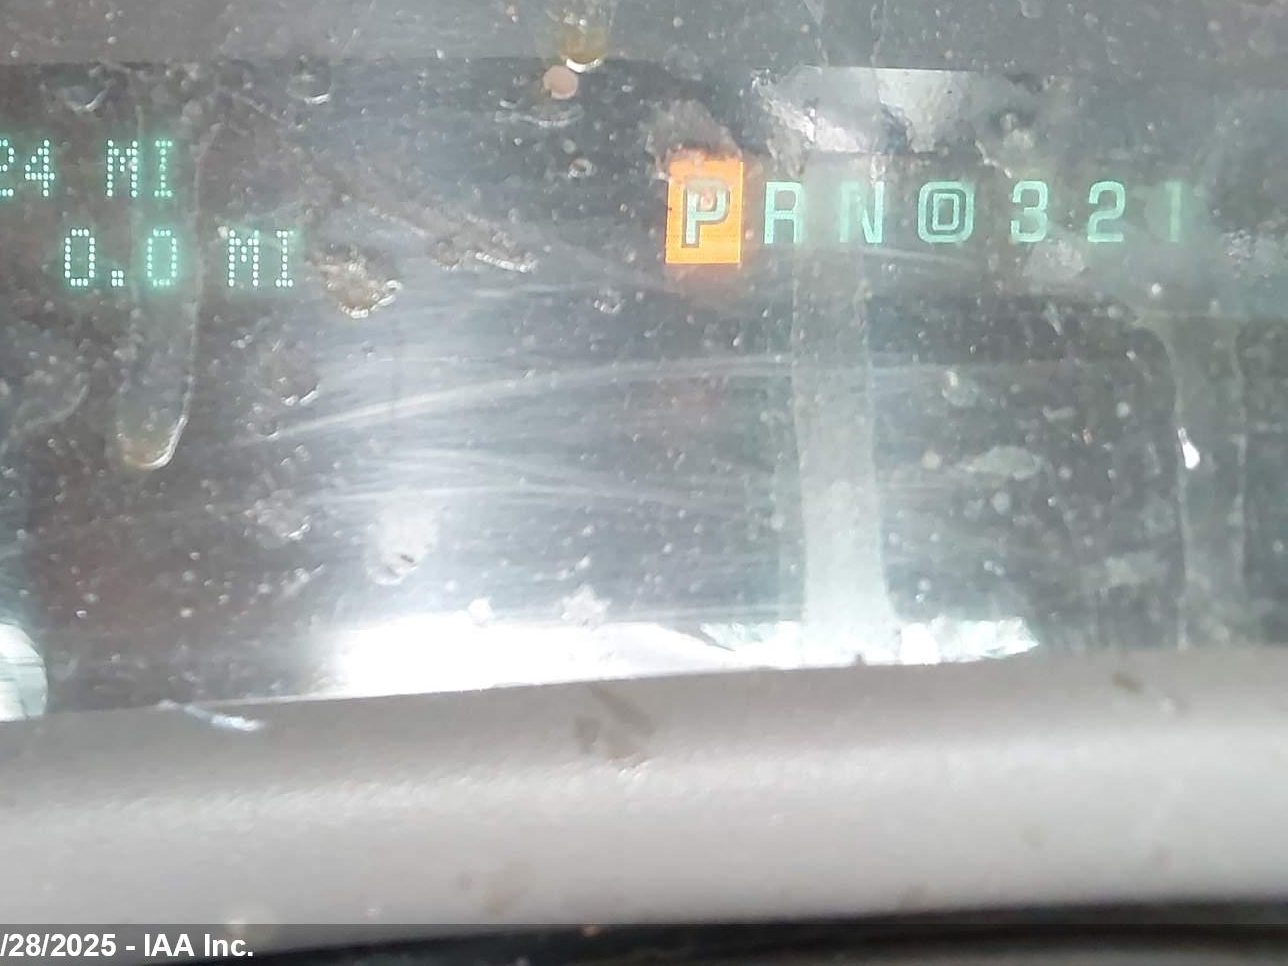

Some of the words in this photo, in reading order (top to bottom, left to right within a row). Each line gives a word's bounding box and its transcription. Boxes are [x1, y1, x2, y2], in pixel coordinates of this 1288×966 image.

[105, 139, 174, 198] MI
[682, 177, 730, 249] P
[762, 179, 803, 245] R
[837, 179, 885, 245] N
[1010, 179, 1050, 244] 3
[1086, 179, 1127, 244] 2
[63, 228, 178, 288] 0.0
[227, 229, 296, 288] MI
